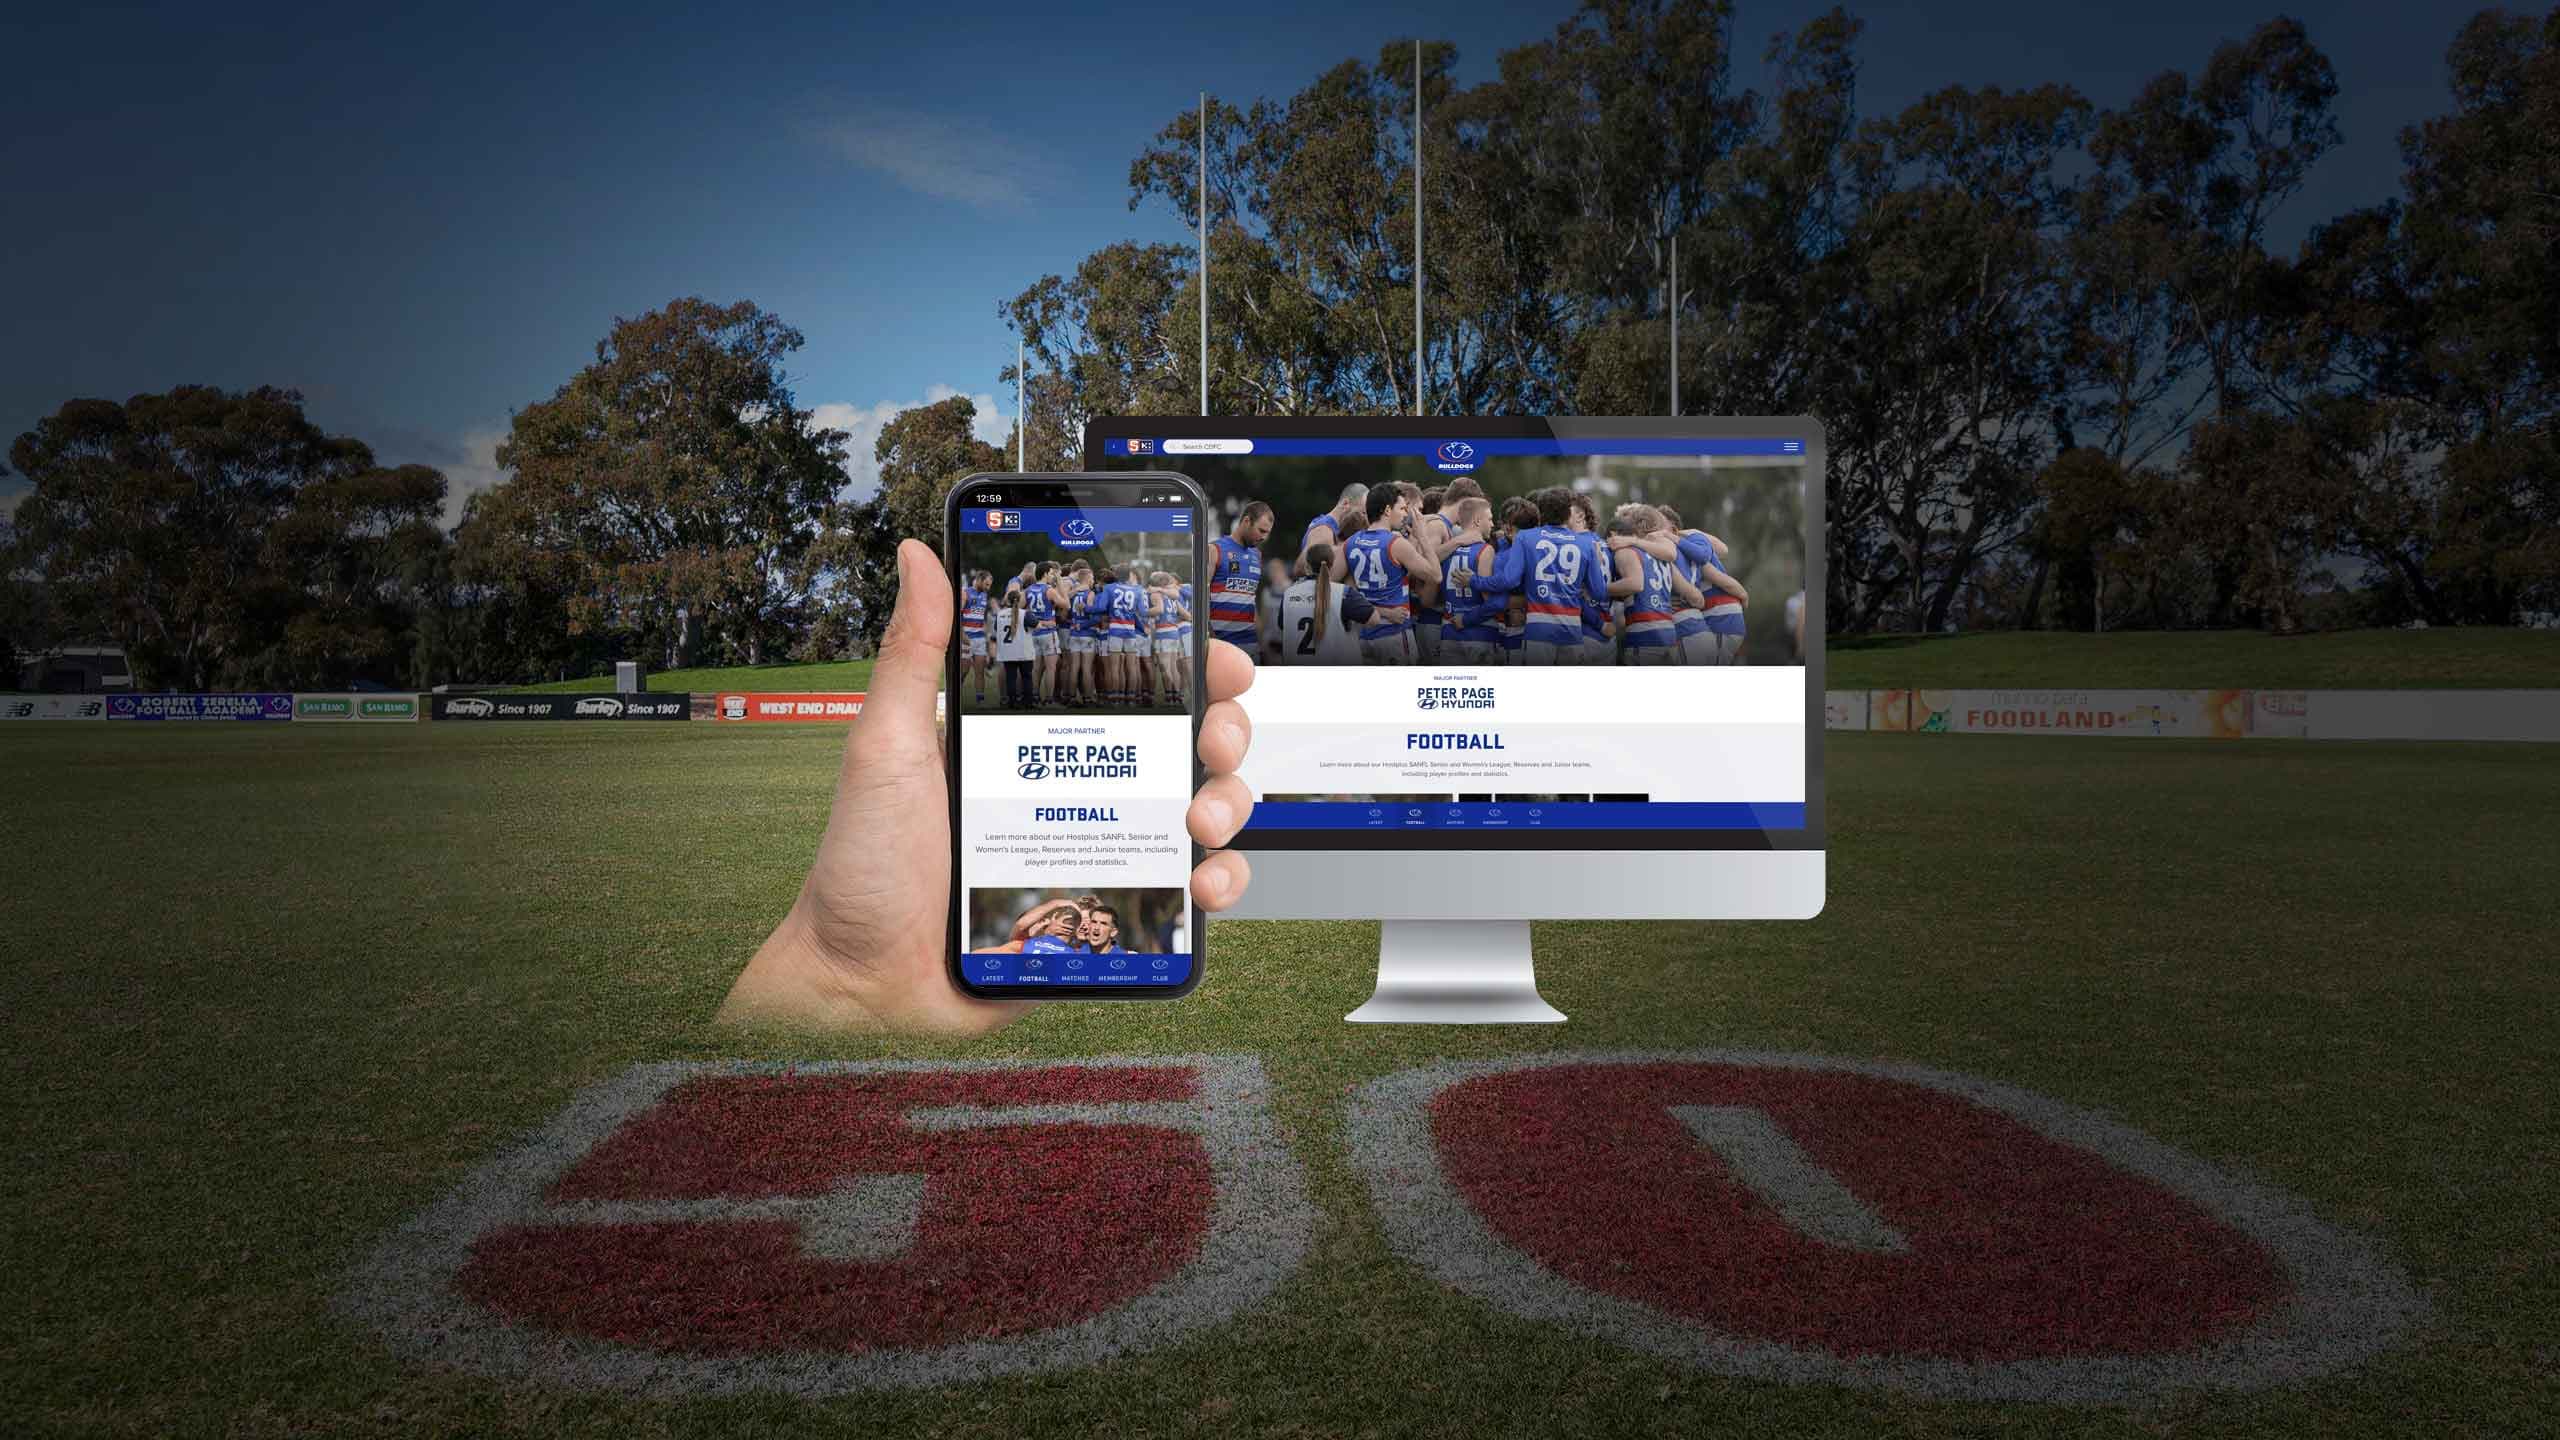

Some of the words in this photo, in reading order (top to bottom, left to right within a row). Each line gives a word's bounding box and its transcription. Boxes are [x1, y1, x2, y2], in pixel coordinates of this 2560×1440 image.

[976, 494, 1002, 503] 12:59
[1349, 547, 1388, 589] 24
[1535, 539, 1581, 585] 29
[1027, 591, 1046, 613] 24
[1113, 588, 1135, 609] 29
[1003, 625, 1012, 643] 2
[1297, 617, 1316, 656] 2
[1418, 687, 1457, 699] PETER
[1462, 687, 1494, 699] PAGE
[142, 697, 196, 706] ROBERT
[202, 697, 258, 706] ZERELLA
[304, 703, 320, 712] SAN
[321, 703, 345, 712] REMO
[366, 704, 383, 712] SAN
[446, 699, 490, 717] Burley
[498, 704, 526, 714] Since
[528, 704, 552, 714] 1907
[576, 699, 620, 717] Burley
[627, 704, 654, 714] Since
[657, 704, 681, 714] 1907
[760, 702, 795, 714] WEST
[797, 702, 824, 714] END
[1442, 700, 1495, 709] HYUNDAI
[136, 706, 197, 715] FOOTBALL
[204, 706, 263, 715] ACADEMY
[1968, 710, 2113, 728] FOODLAND
[1408, 733, 1504, 749] FOOTBALL
[1018, 745, 1079, 762] PETER
[1086, 745, 1136, 762] PAGE
[1055, 765, 1136, 778] HYUNDAI
[1036, 808, 1118, 821] FOOTBALL
[985, 833, 1006, 841] Learn
[1029, 833, 1051, 841] about
[1067, 833, 1099, 842] Hostplus
[1100, 833, 1126, 841] SANFL
[1128, 833, 1152, 841] Senior
[1154, 833, 1168, 841] and
[1010, 846, 1040, 854] League,
[1118, 846, 1143, 854] teams,
[1144, 846, 1178, 854] including
[1025, 858, 1048, 867] player
[1050, 858, 1077, 867] profiles
